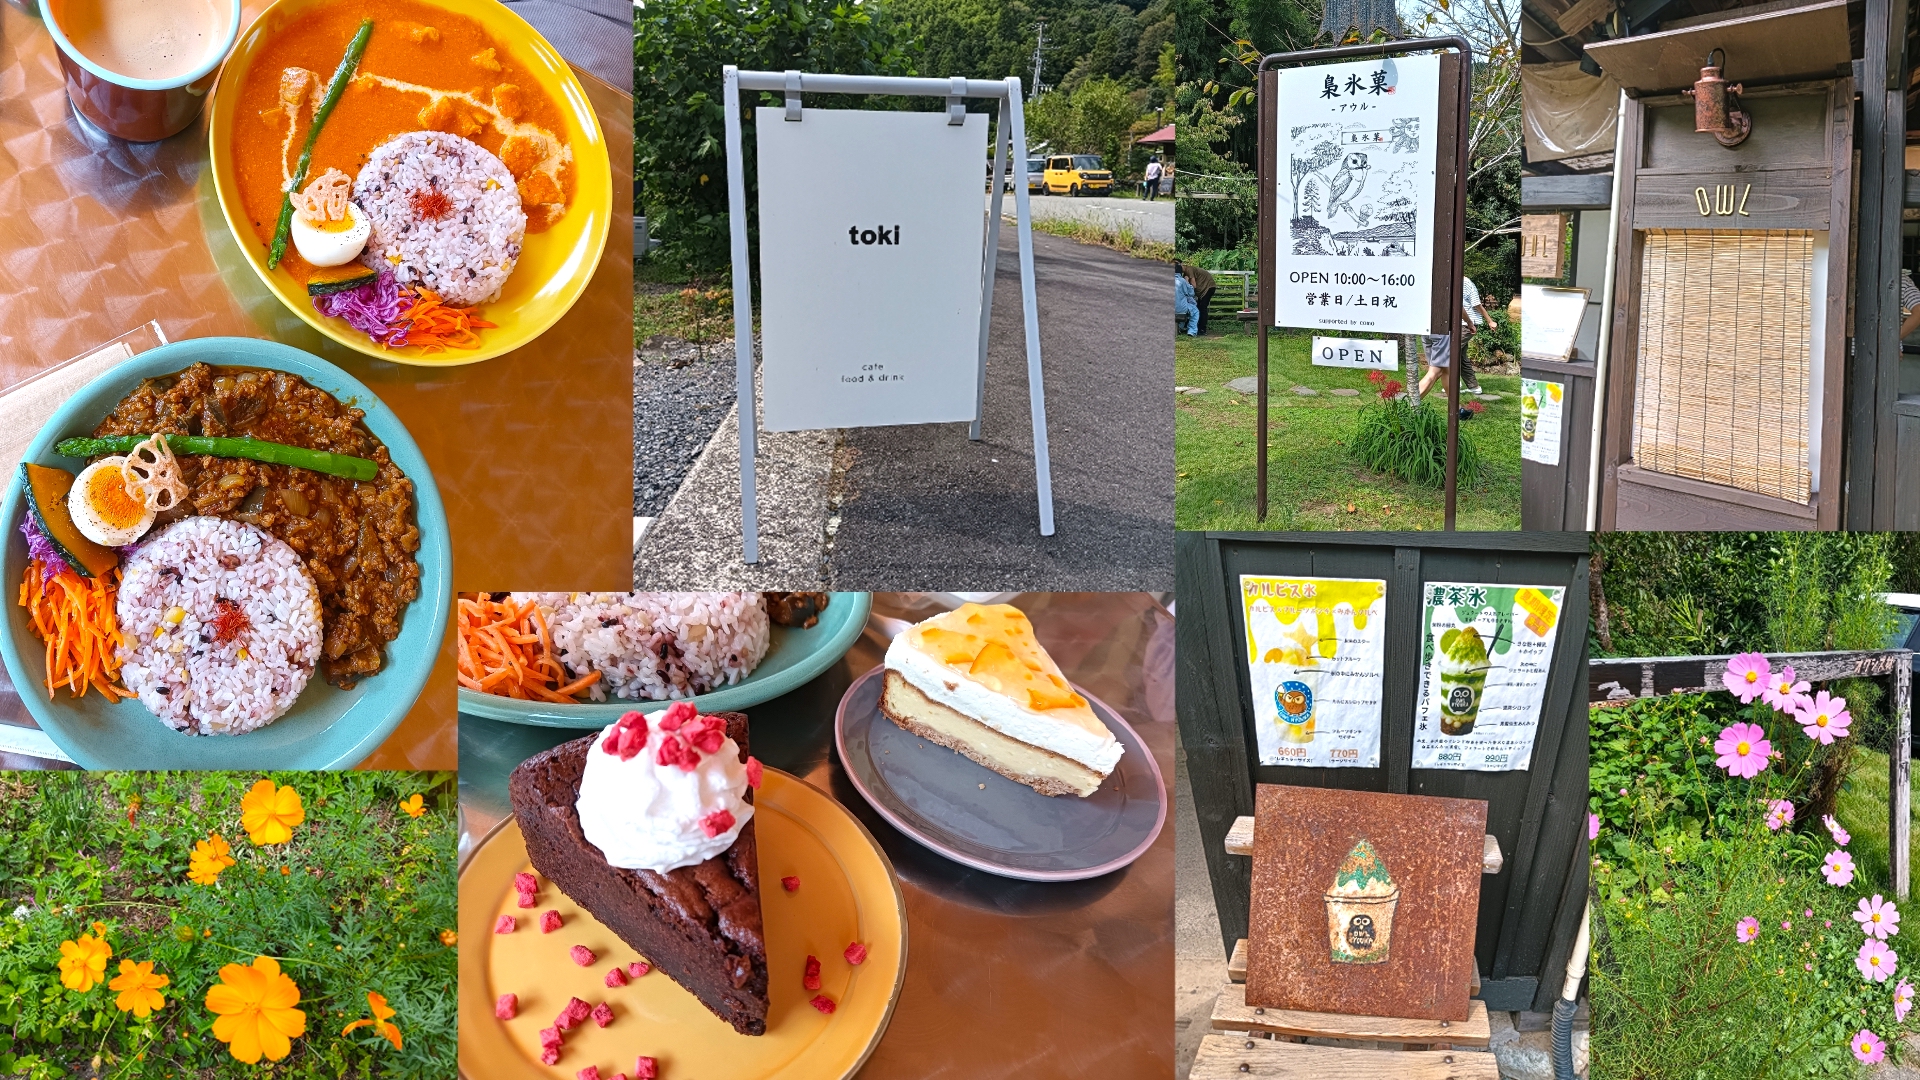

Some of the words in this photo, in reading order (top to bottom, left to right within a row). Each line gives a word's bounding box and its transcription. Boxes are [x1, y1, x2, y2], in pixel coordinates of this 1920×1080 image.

[1319, 69, 1391, 99] 梟氷菓
[1695, 184, 1751, 216] OWL
[849, 225, 900, 245] toki
[1290, 271, 1329, 284] OPEN
[1322, 346, 1382, 363] OPEN
[862, 363, 884, 371] cafe
[841, 374, 864, 383] food
[868, 374, 874, 382] &
[879, 374, 905, 382] drink
[1247, 582, 1317, 598] カルピス氷
[1427, 586, 1487, 607] 濃茶氷
[1278, 746, 1306, 757] 660円
[1330, 748, 1359, 758] 770円
